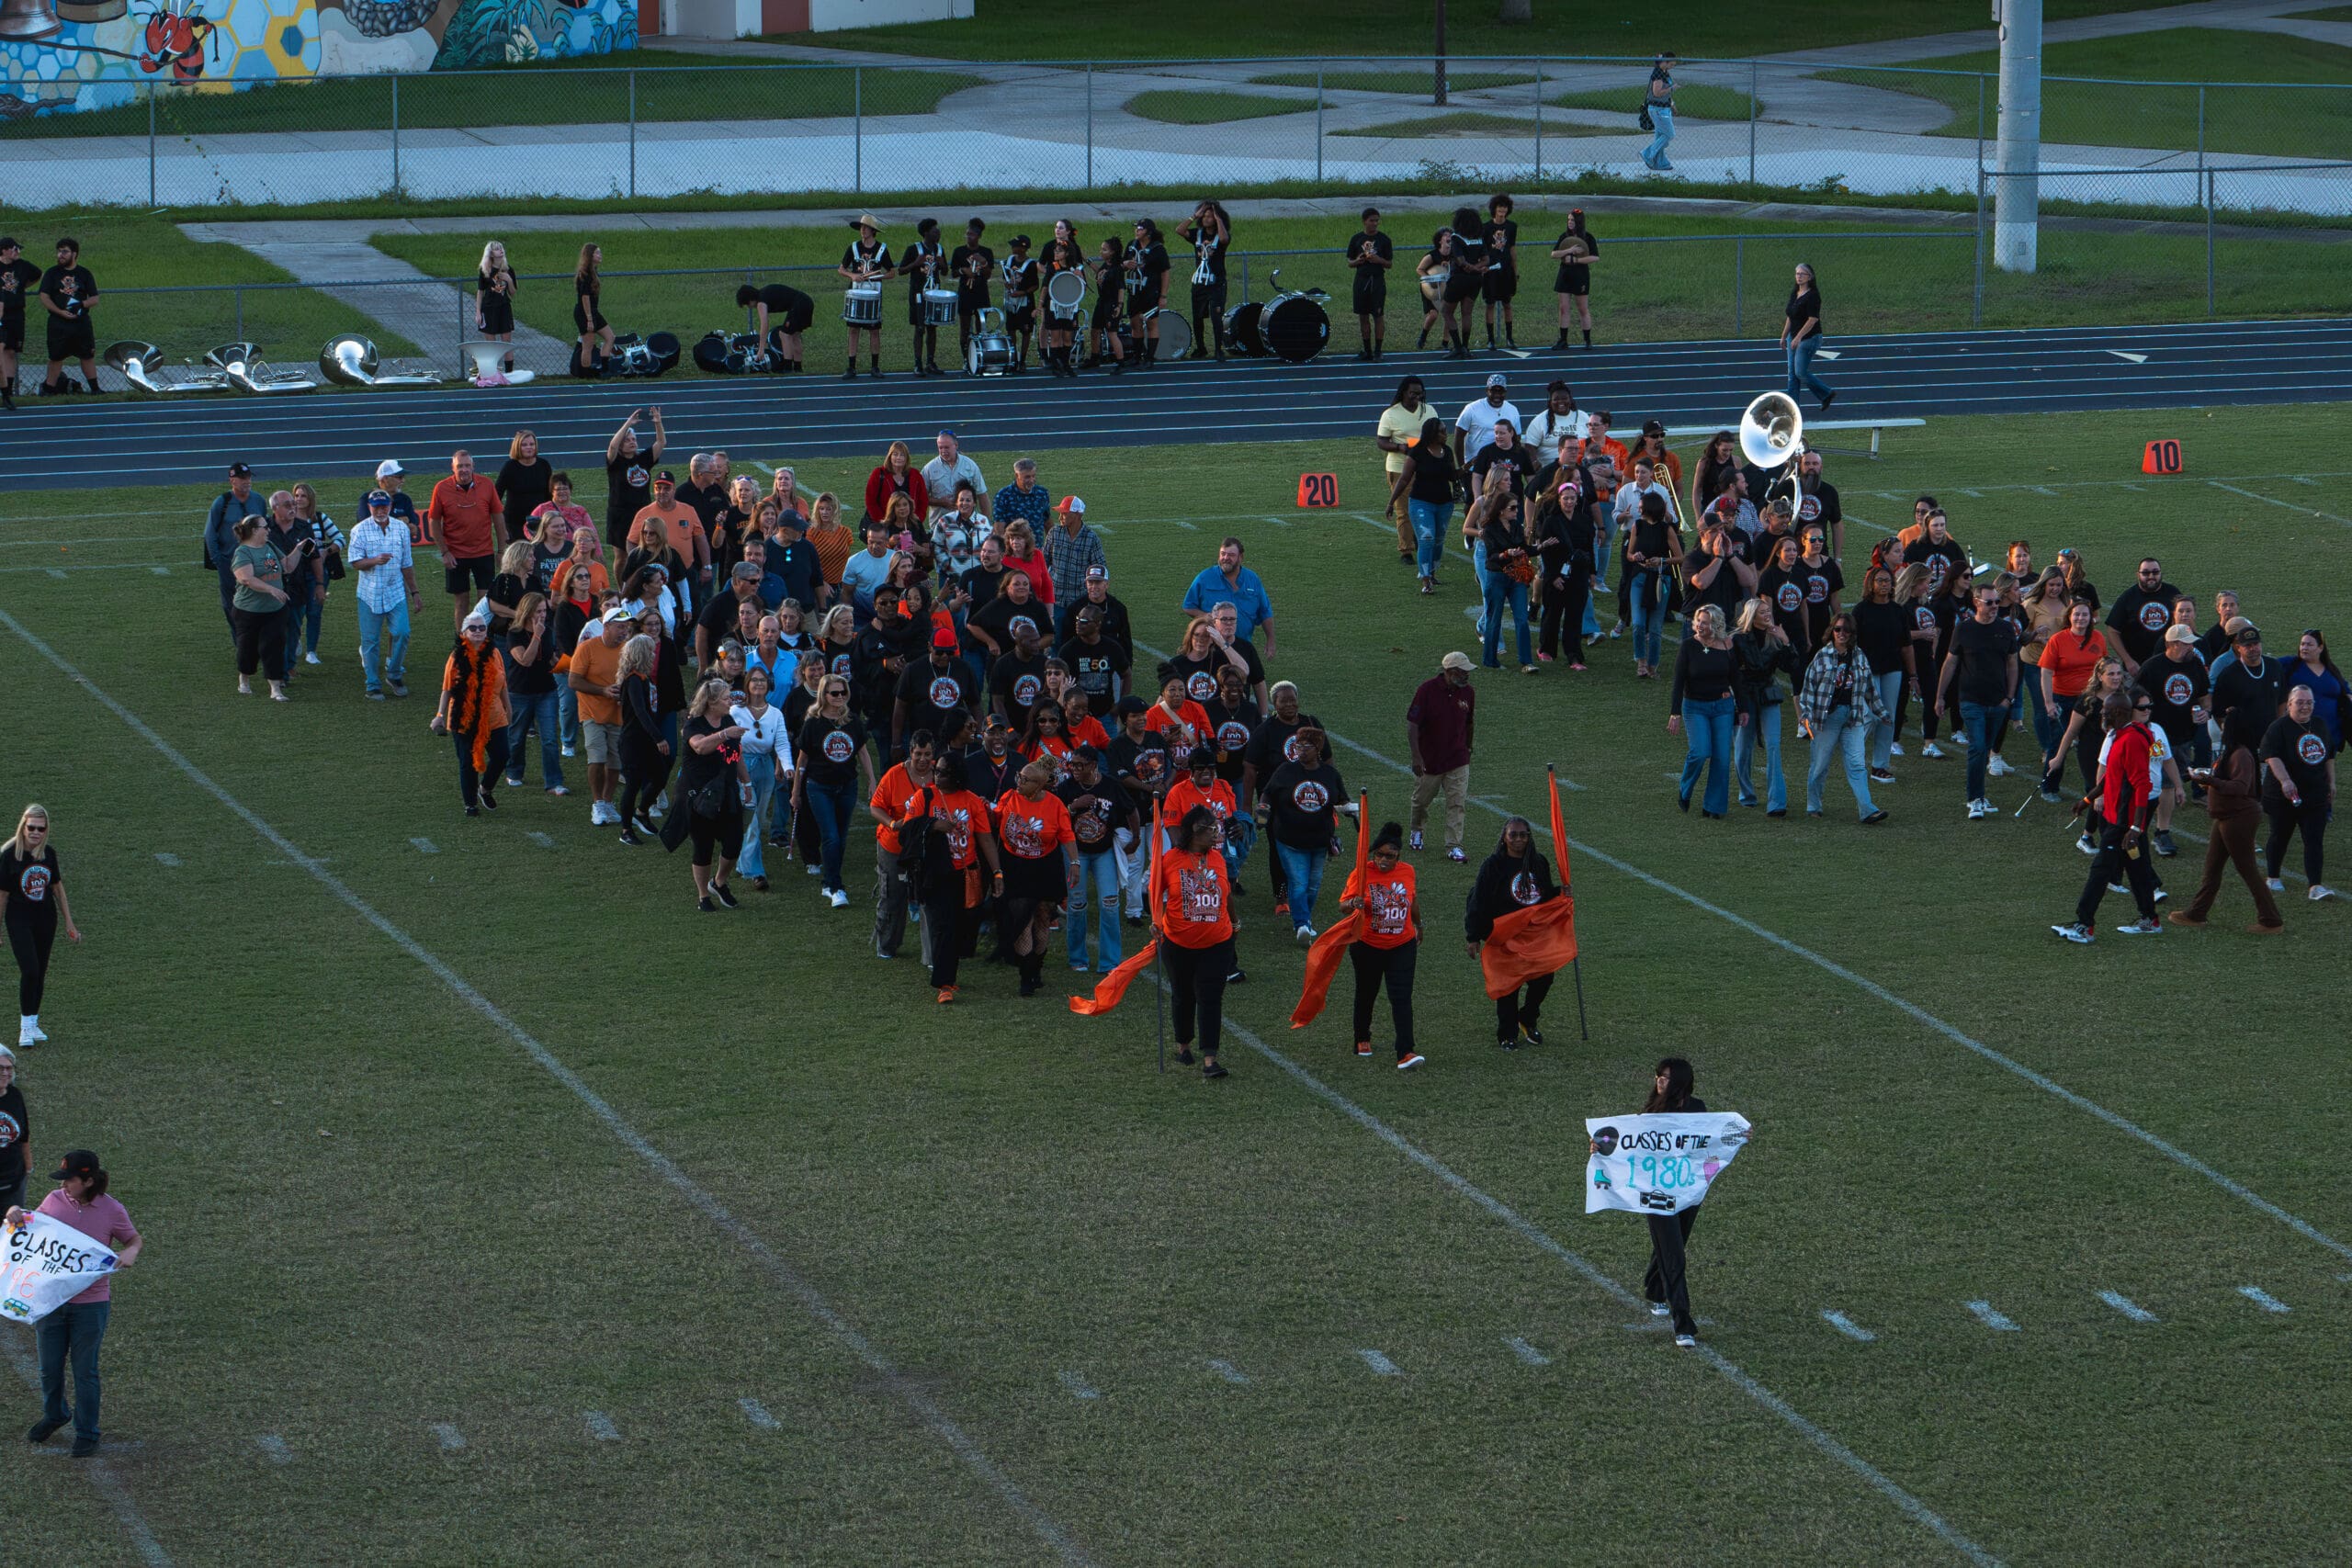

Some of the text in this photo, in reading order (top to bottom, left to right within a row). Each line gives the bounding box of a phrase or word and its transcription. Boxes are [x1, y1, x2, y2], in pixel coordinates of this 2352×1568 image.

[2151, 441, 2180, 472] 10
[1305, 475, 1336, 506] 20
[1175, 746, 1192, 758] 10
[1194, 894, 1220, 908] 100
[1384, 907, 1408, 919] 100
[1621, 1130, 1712, 1152] CLASSES OF THE
[10, 1231, 92, 1273] CLASSES
[11, 1252, 63, 1275] OF THE
